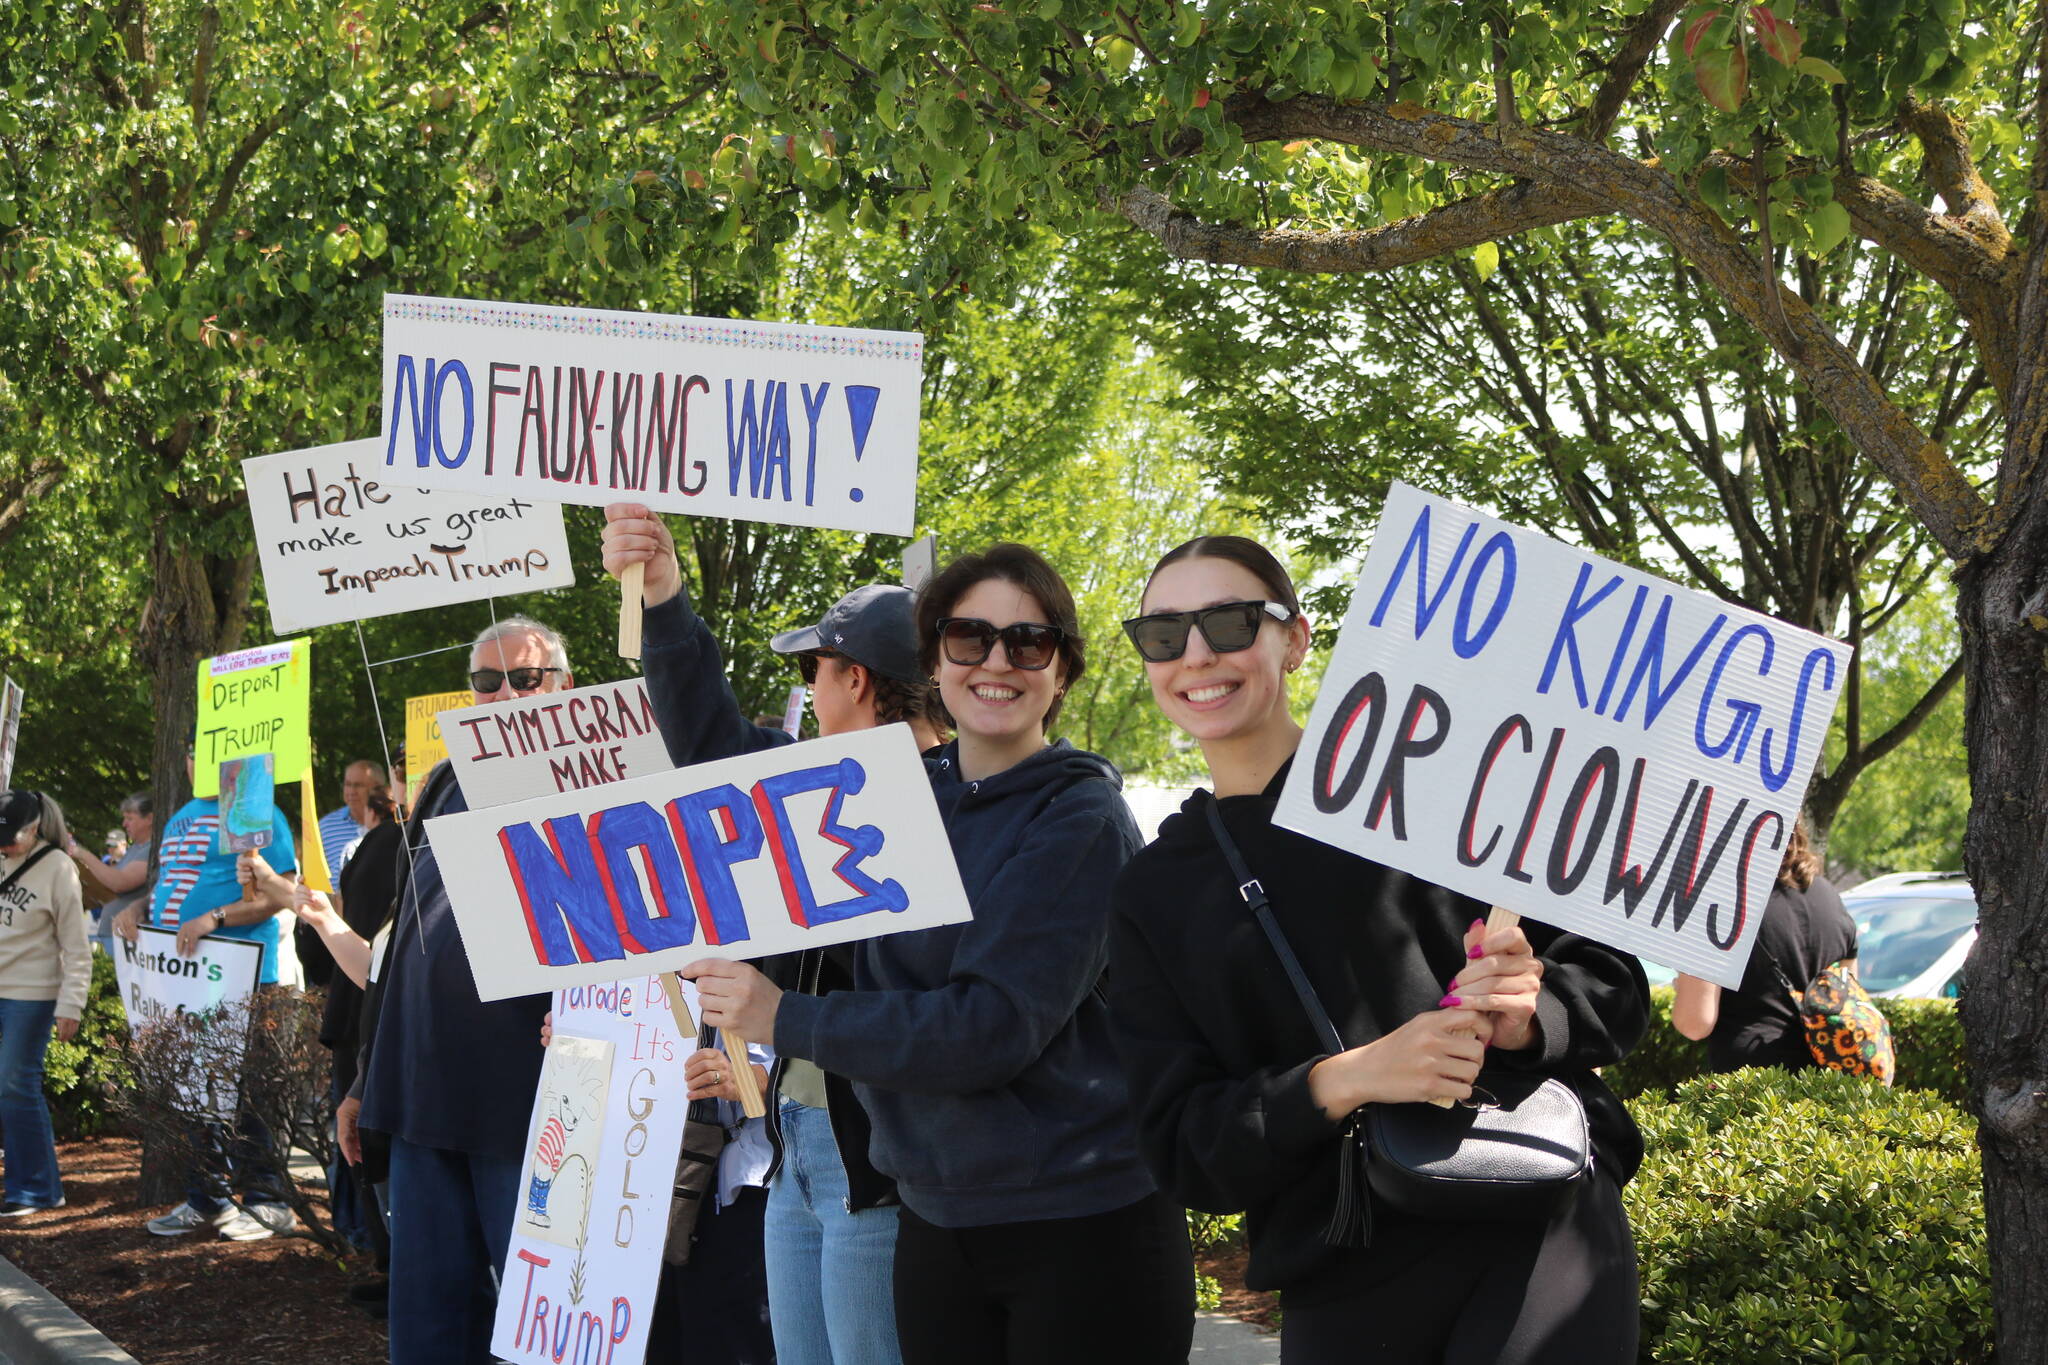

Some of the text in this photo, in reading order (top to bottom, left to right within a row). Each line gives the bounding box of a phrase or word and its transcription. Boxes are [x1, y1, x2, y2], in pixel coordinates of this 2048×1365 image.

[386, 354, 474, 470] NO
[484, 361, 710, 497] FAUX-KING
[283, 462, 391, 524] Hate
[278, 498, 533, 556] make us great
[318, 543, 550, 595] Impeach Trump
[1368, 504, 1836, 793] NO KINGS
[212, 664, 287, 711] DEPORT
[1312, 671, 1785, 952] OR CLOWNS
[498, 757, 910, 966] NOPE
[121, 937, 223, 982] Renton's
[630, 1022, 674, 1061] It's
